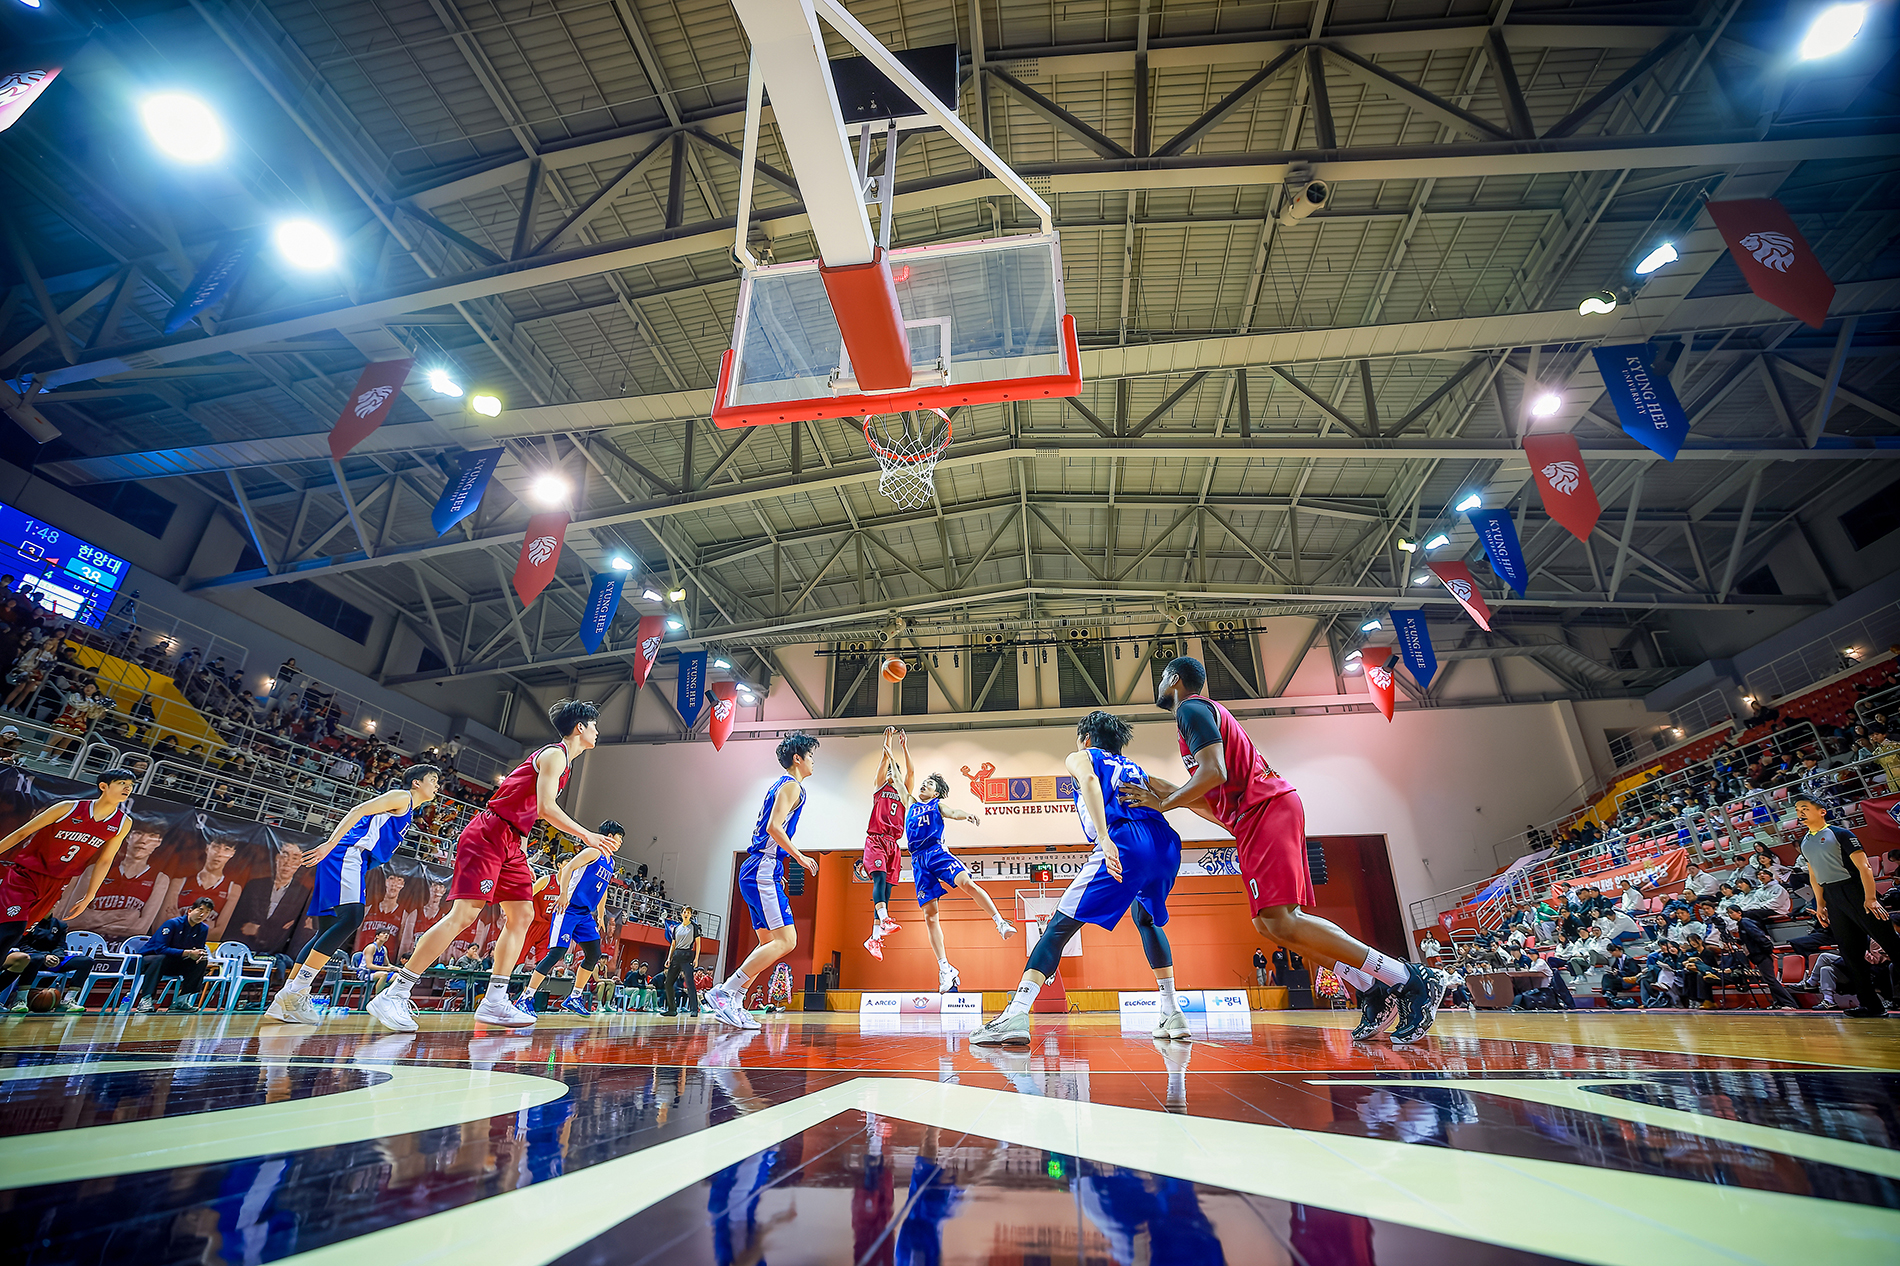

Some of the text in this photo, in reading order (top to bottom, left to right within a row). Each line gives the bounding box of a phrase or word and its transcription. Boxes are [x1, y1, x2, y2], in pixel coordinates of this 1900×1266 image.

[1622, 369, 1646, 414] UNIVERSITY
[1626, 356, 1668, 430] KYUNG HEE
[450, 458, 487, 512] KYUNG HEE
[25, 520, 60, 544] 1:48
[1489, 520, 1516, 578] KYUNG HEE
[78, 544, 122, 574] 한양대
[79, 566, 102, 584] 38
[595, 580, 615, 634] KYUNG HEE
[1407, 618, 1426, 668] KYUNG HEE
[690, 660, 698, 689] KYUNG
[15, 773, 35, 794] 11
[890, 802, 898, 816] 9
[984, 804, 1078, 815] KYUNG HEE UNIVE
[918, 814, 930, 827] 24
[54, 830, 91, 843] KYUNG
[60, 845, 80, 862] 3
[946, 860, 961, 874] 24
[993, 861, 1032, 875] THE
[1042, 871, 1049, 881] 6
[596, 881, 603, 892] 4
